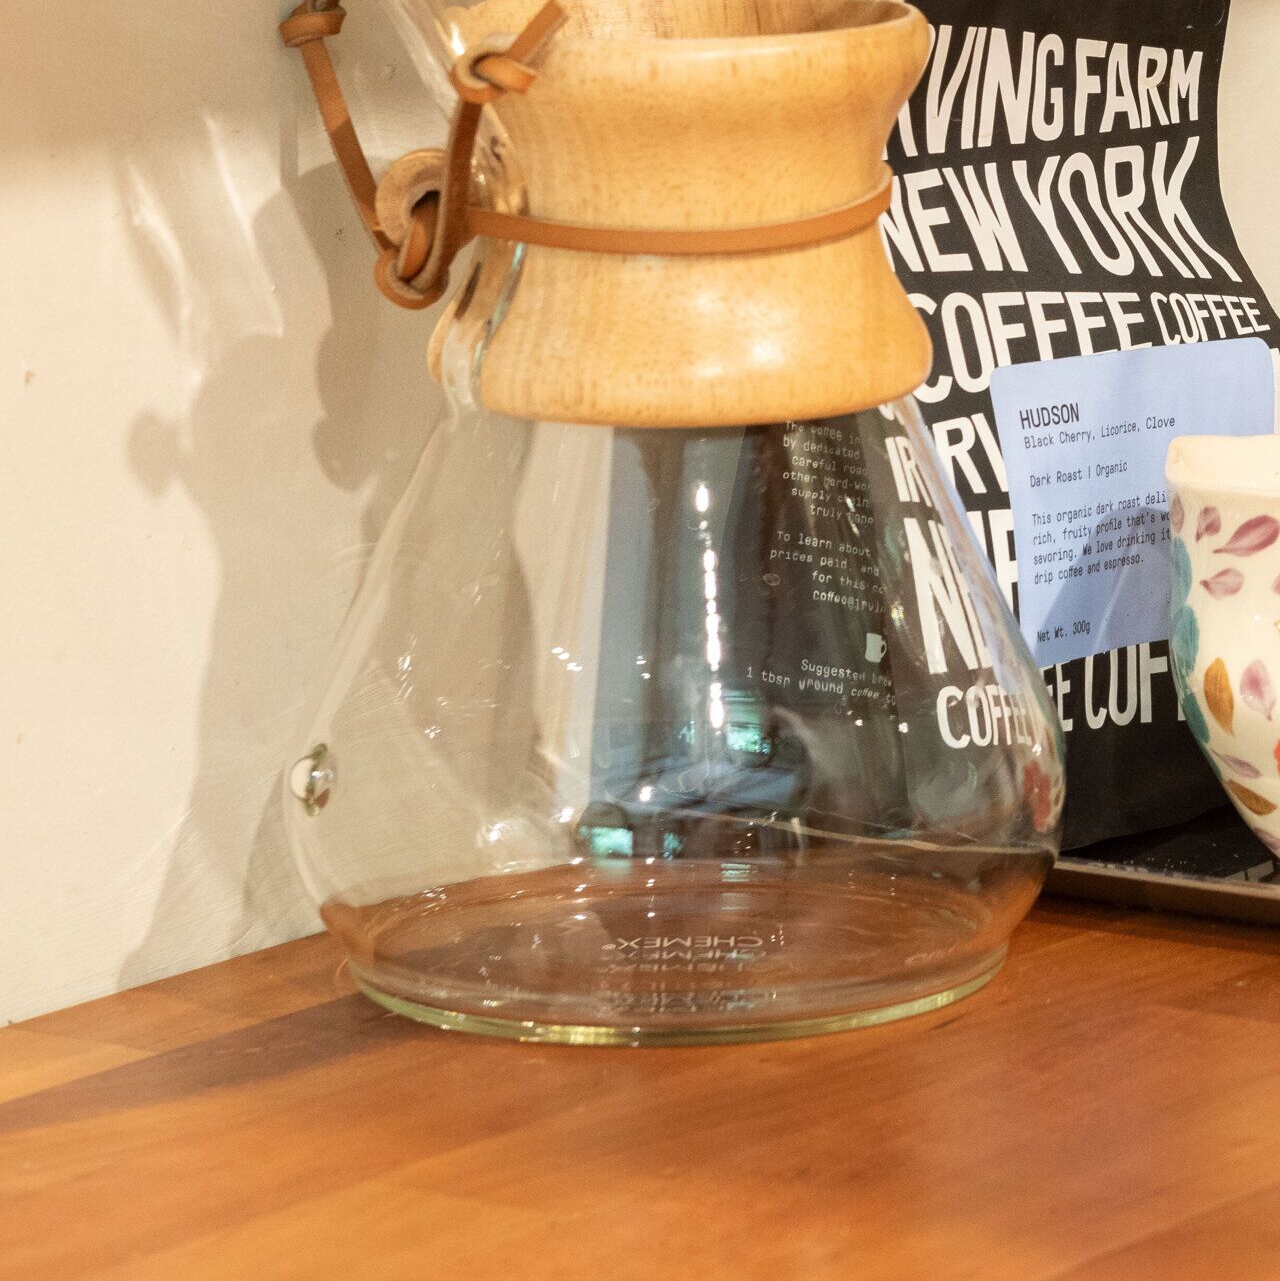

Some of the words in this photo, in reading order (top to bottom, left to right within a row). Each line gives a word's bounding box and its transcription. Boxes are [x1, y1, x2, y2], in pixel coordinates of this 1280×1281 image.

[1074, 38, 1203, 137] FARM
[879, 162, 1028, 273] NEW
[1012, 136, 1242, 282] YORK
[1150, 292, 1271, 345] COFFEE
[1019, 403, 1080, 430] HUDSON
[783, 435, 796, 451] by
[1024, 436, 1054, 450] Black
[1059, 430, 1095, 446] Cherry,
[1101, 422, 1140, 438] Licorice,
[1145, 416, 1176, 430] Clove
[782, 470, 818, 483] other
[792, 455, 836, 471] careful
[1030, 474, 1051, 488] Dark
[1056, 469, 1083, 484] Roast
[1096, 460, 1128, 479] Organic
[791, 487, 831, 502] supply
[1032, 513, 1051, 527] This
[1057, 506, 1092, 523] organic
[1096, 501, 1113, 515] dark
[1118, 495, 1141, 510] roast
[1145, 490, 1167, 506] deli
[810, 504, 842, 520] truly
[1033, 531, 1056, 546] rich,
[1063, 525, 1092, 540] fruity
[1096, 519, 1122, 536] profile
[1127, 512, 1156, 528] that's
[1160, 512, 1170, 521] wo
[770, 549, 813, 563] prices
[777, 530, 791, 542] To
[798, 533, 832, 550] learn
[839, 543, 871, 558] about
[1033, 548, 1077, 566] savoring.
[1082, 544, 1092, 556] We
[1097, 539, 1113, 553] love
[1117, 530, 1156, 549] drinking
[812, 570, 832, 584] for
[839, 576, 866, 590] this
[1034, 570, 1053, 586] drip
[1058, 564, 1083, 580] coffee
[1087, 562, 1101, 574] and
[1104, 553, 1144, 570] espresso.
[1037, 630, 1050, 643] Net
[1054, 625, 1068, 639] Wt.
[1073, 619, 1090, 636] 300g
[746, 666, 753, 678] 1
[851, 688, 880, 700] coffee
[801, 659, 865, 680] Suggested
